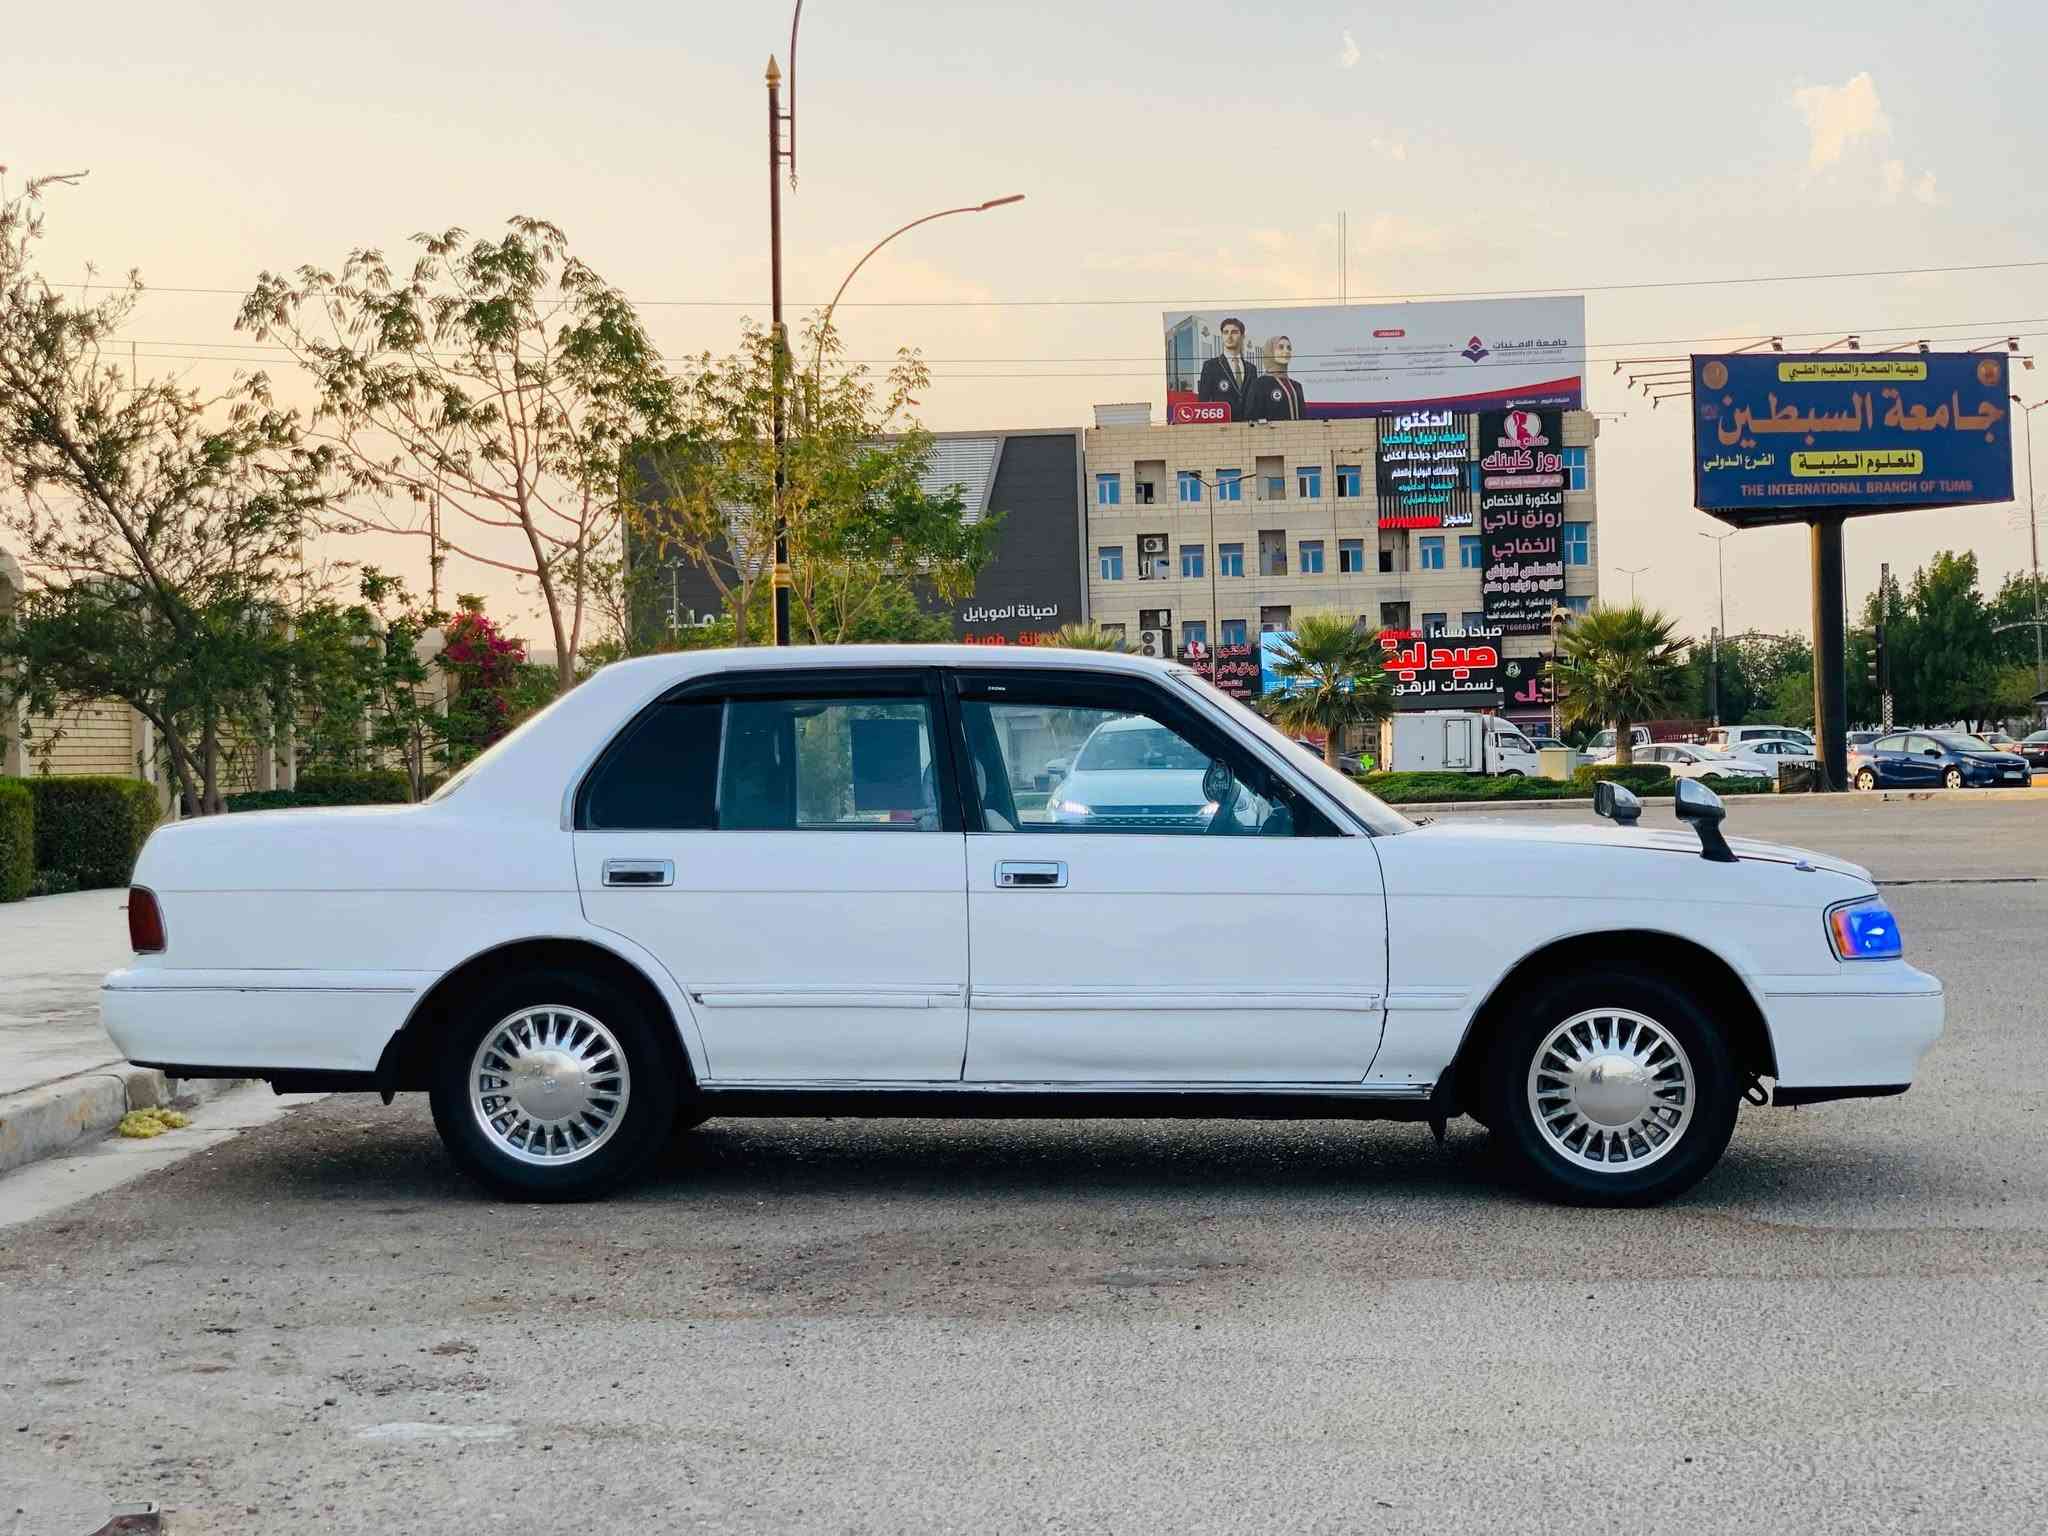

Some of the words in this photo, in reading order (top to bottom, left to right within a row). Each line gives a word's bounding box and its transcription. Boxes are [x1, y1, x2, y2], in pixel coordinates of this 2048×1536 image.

[1789, 363, 1818, 379] الطبي
[1820, 363, 1859, 378] والتعليم
[1861, 362, 1894, 375] الصحة
[1194, 408, 1225, 420] 7668
[1394, 410, 1453, 431] الدكتور
[1717, 391, 1874, 448] السبطين
[1882, 387, 2005, 443] جامعة
[1415, 432, 1437, 446] نبيل
[1407, 450, 1431, 461] جراحة
[1481, 450, 1534, 474] كلينك
[1536, 451, 1563, 472] روز
[1703, 455, 1743, 473] الدولي
[1744, 453, 1775, 471] الفرع
[1798, 453, 1864, 475] الطبية
[1866, 453, 1916, 473] للعلوم
[1741, 483, 1766, 497] THE
[1768, 482, 1861, 496] INTERNATIONAL
[1866, 480, 1918, 494] BRANCH
[1919, 480, 1936, 493] OF
[1482, 493, 1524, 510] الاختصاص
[1525, 491, 1562, 508] الدكتورة
[1443, 512, 1473, 528] للحجز
[1483, 510, 1518, 534] ناجي
[1522, 510, 1562, 529] رونق
[1491, 536, 1556, 562] الخفاجي
[1520, 560, 1563, 579] اختصاص
[963, 604, 1015, 622] الموبايل
[1018, 603, 1058, 620] لصيانة
[1469, 625, 1503, 639] صباحا
[1441, 678, 1494, 692] نسمات
